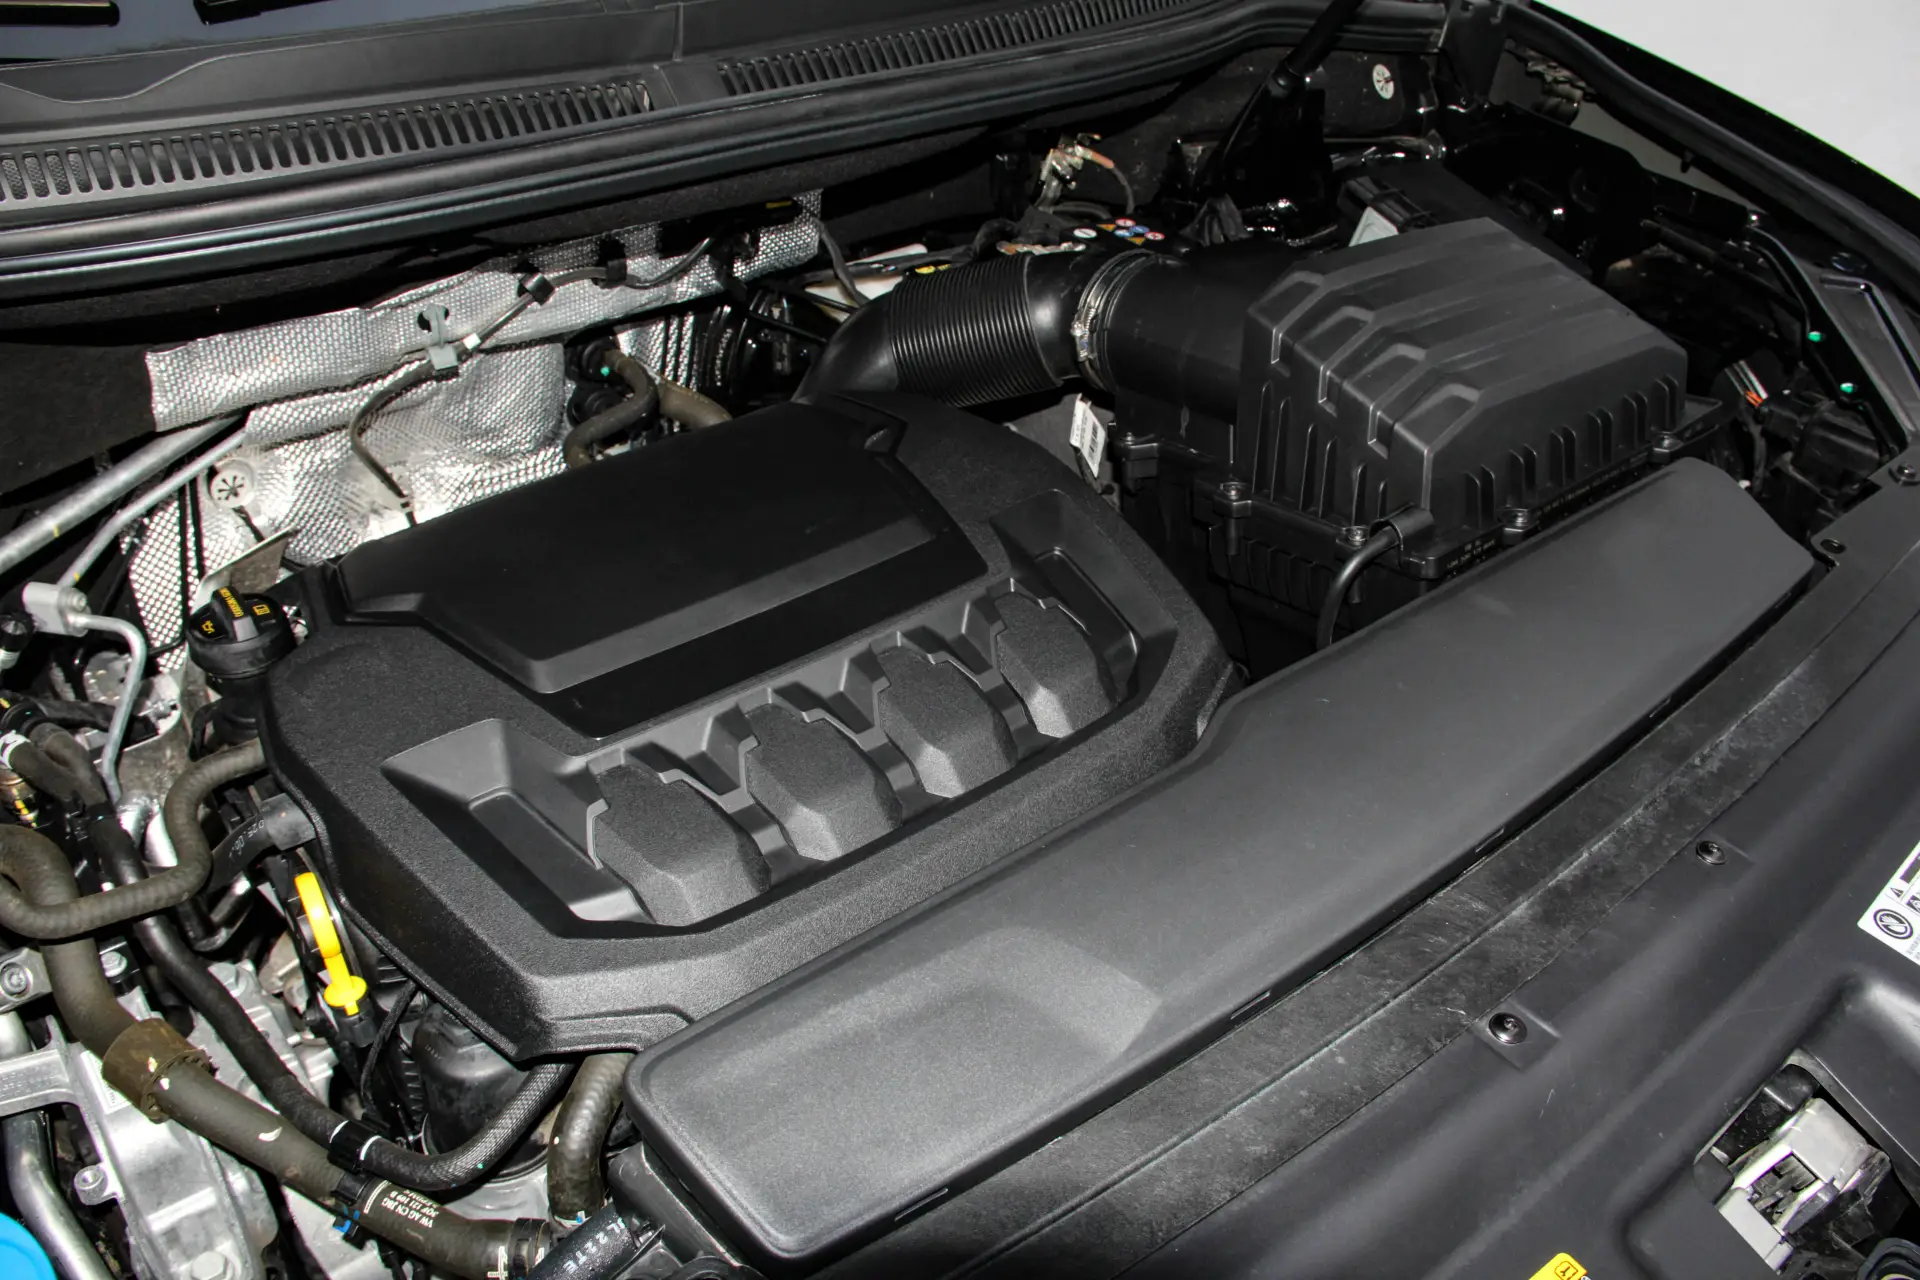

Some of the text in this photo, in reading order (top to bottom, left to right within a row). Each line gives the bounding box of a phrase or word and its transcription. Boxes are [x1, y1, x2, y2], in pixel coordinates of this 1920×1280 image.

[395, 1204, 409, 1216] CN
[408, 1210, 421, 1221] AG
[420, 1217, 434, 1228] VW
